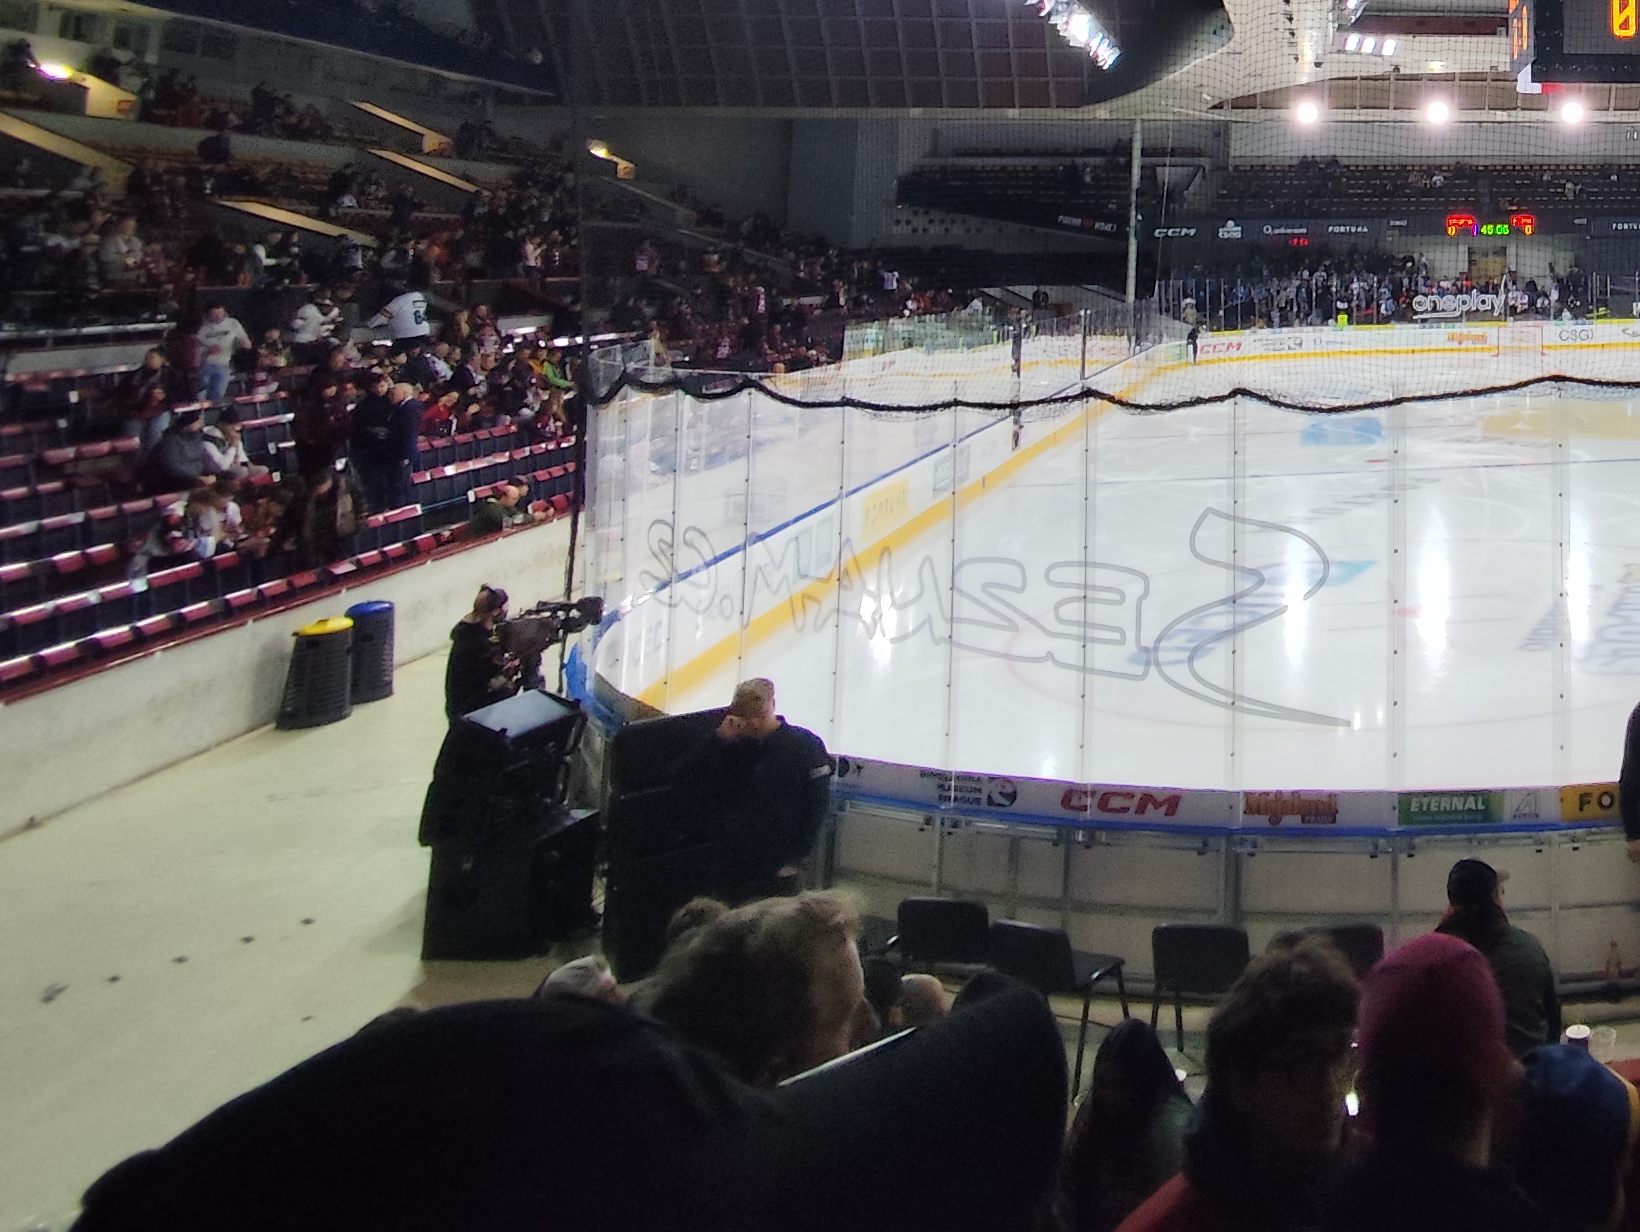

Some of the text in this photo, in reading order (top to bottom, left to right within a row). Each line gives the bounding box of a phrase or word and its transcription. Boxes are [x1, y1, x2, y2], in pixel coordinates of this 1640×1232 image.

[1154, 227, 1197, 238] CCM
[1328, 225, 1369, 234] FORTUNA
[1412, 275, 1506, 317] oneplay
[1200, 341, 1242, 355] CCM
[865, 489, 907, 525] FORTUNA
[1061, 787, 1182, 817] CCM
[1410, 795, 1487, 812] ETERNAL
